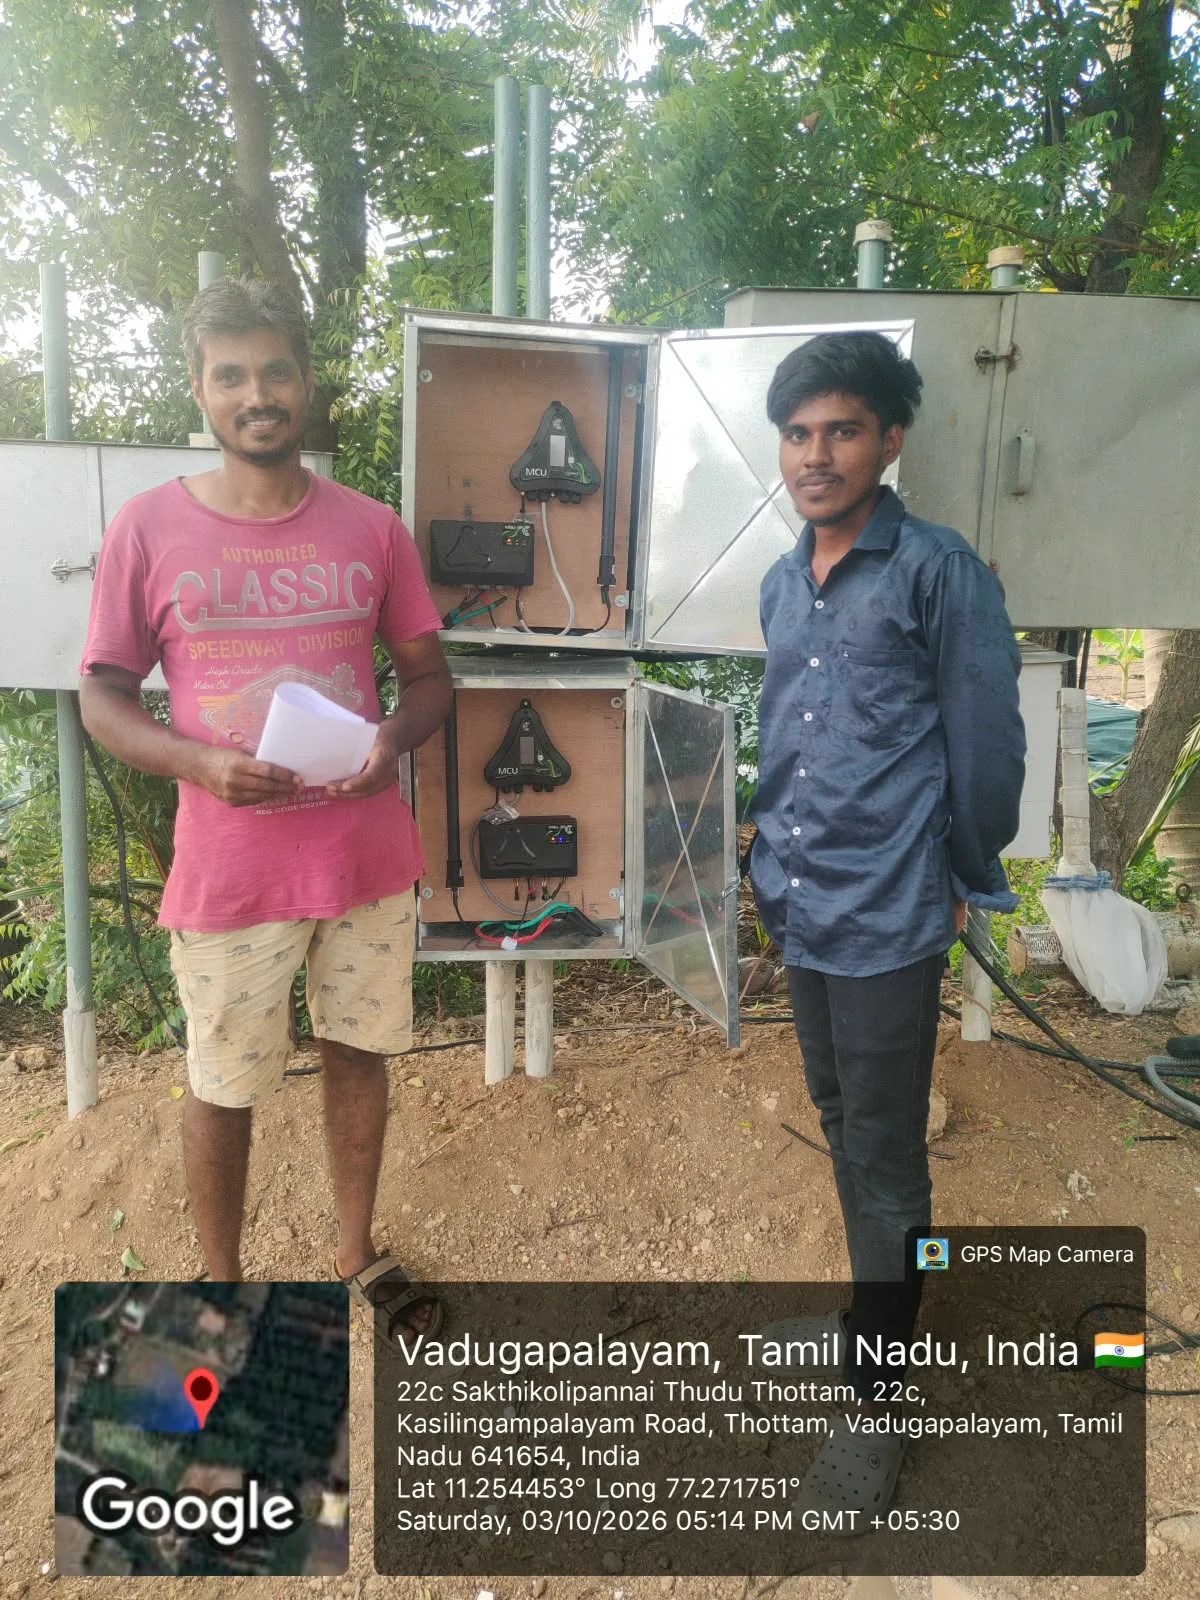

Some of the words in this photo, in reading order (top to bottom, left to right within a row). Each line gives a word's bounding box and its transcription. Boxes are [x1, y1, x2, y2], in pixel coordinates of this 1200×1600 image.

[525, 468, 547, 477] MCU
[222, 543, 317, 564] AUTHORIZED
[171, 562, 373, 634] CLASSIC
[188, 639, 286, 660] SPEEDWAY
[297, 627, 365, 654] DIVISION
[204, 665, 230, 677] High
[231, 664, 264, 675] Grade
[498, 767, 519, 775] MCU
